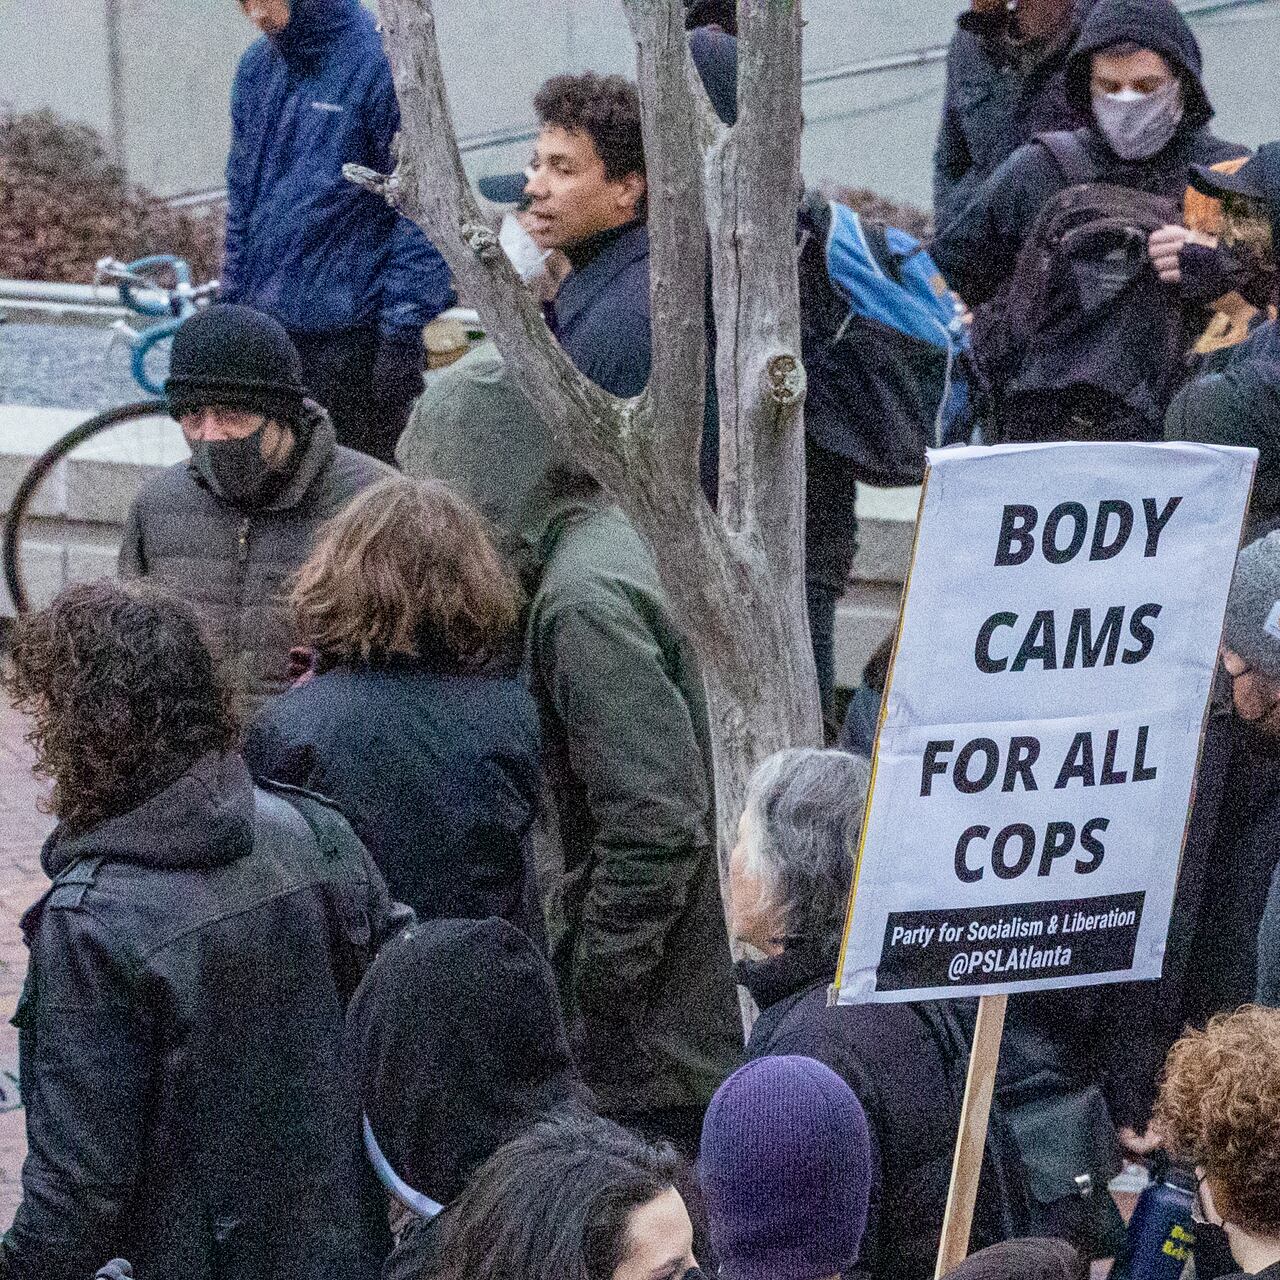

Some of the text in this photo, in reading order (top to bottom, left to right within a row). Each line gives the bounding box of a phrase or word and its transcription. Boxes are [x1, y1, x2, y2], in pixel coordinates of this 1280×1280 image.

[993, 496, 1183, 567] BODY
[974, 603, 1163, 674] CAMS
[919, 725, 1158, 797] FOR ALL
[954, 817, 1111, 884] COPS
[891, 907, 1137, 948] Party for Socialism & Liberation
[948, 945, 1072, 981] @PSLAtlanta
